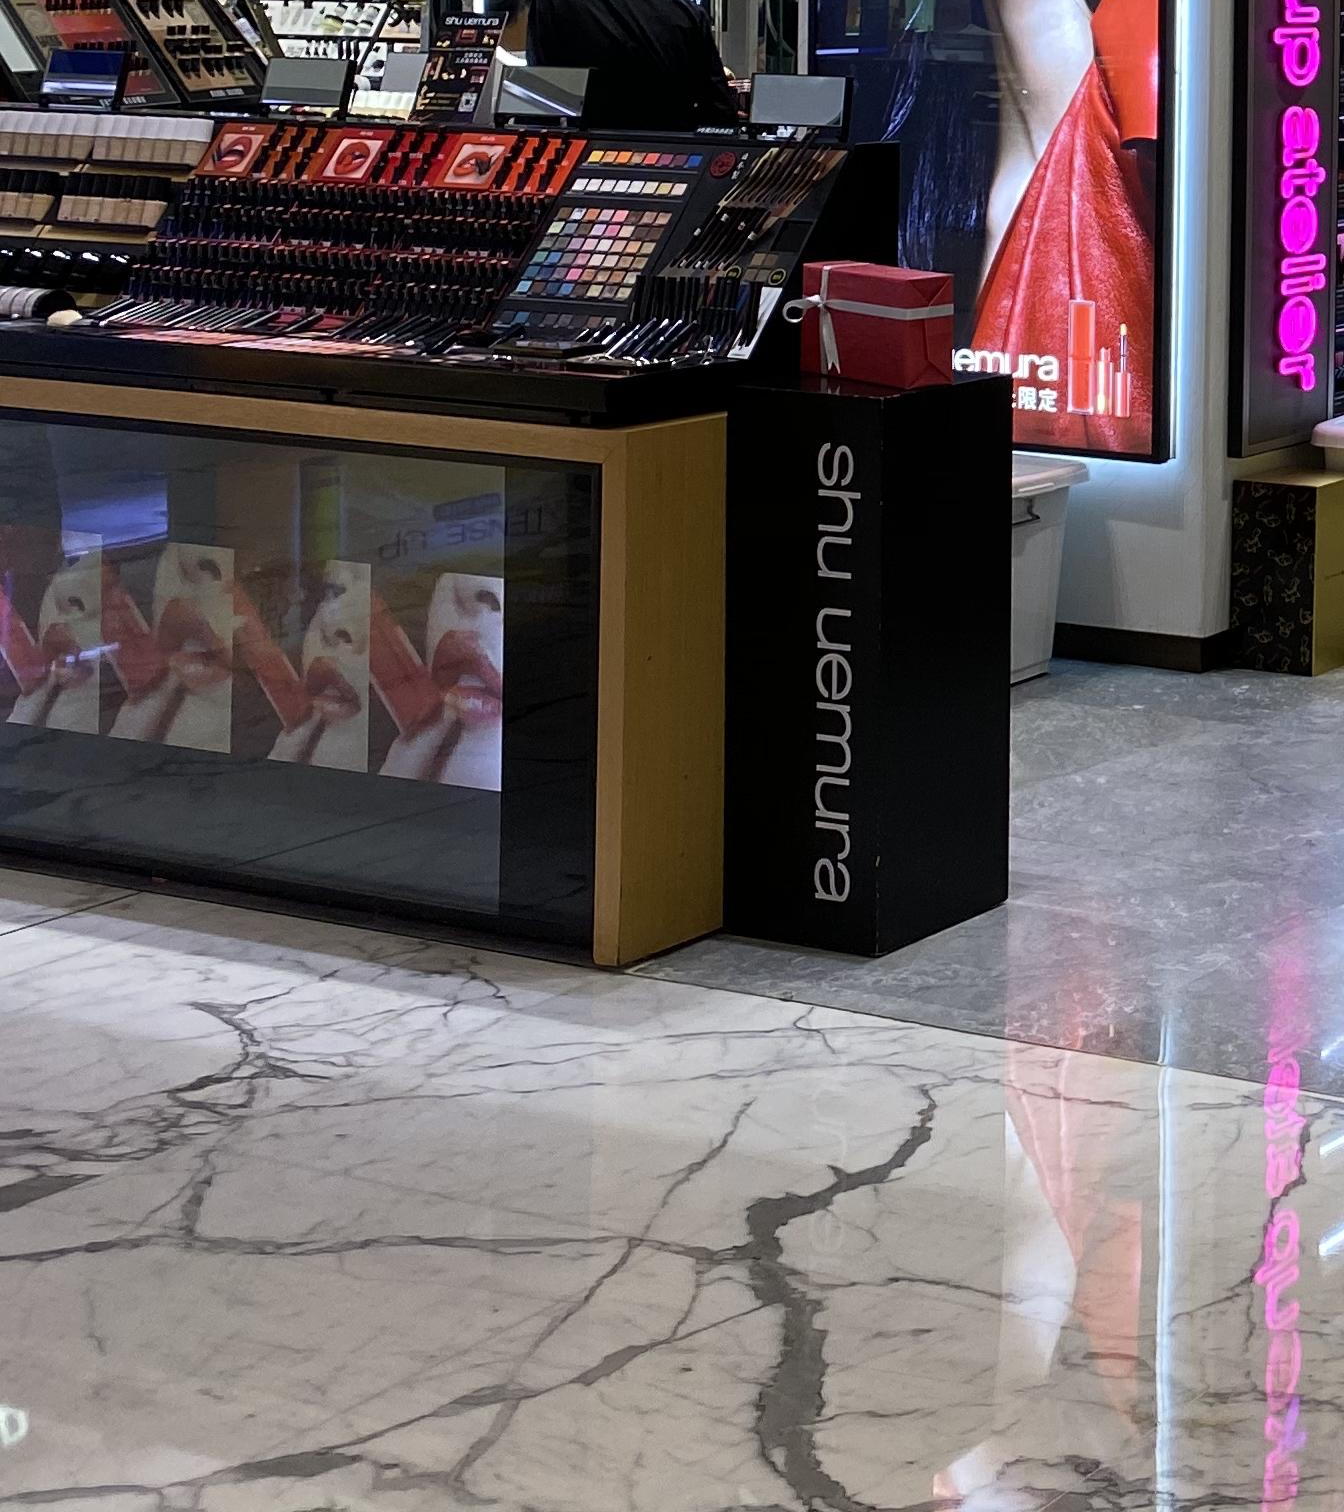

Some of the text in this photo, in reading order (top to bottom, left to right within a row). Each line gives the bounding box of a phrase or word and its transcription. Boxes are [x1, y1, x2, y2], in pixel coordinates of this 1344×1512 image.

[1279, 106, 1327, 392] atelier
[1012, 386, 1058, 413] 限定
[815, 442, 861, 904] shu uemura
